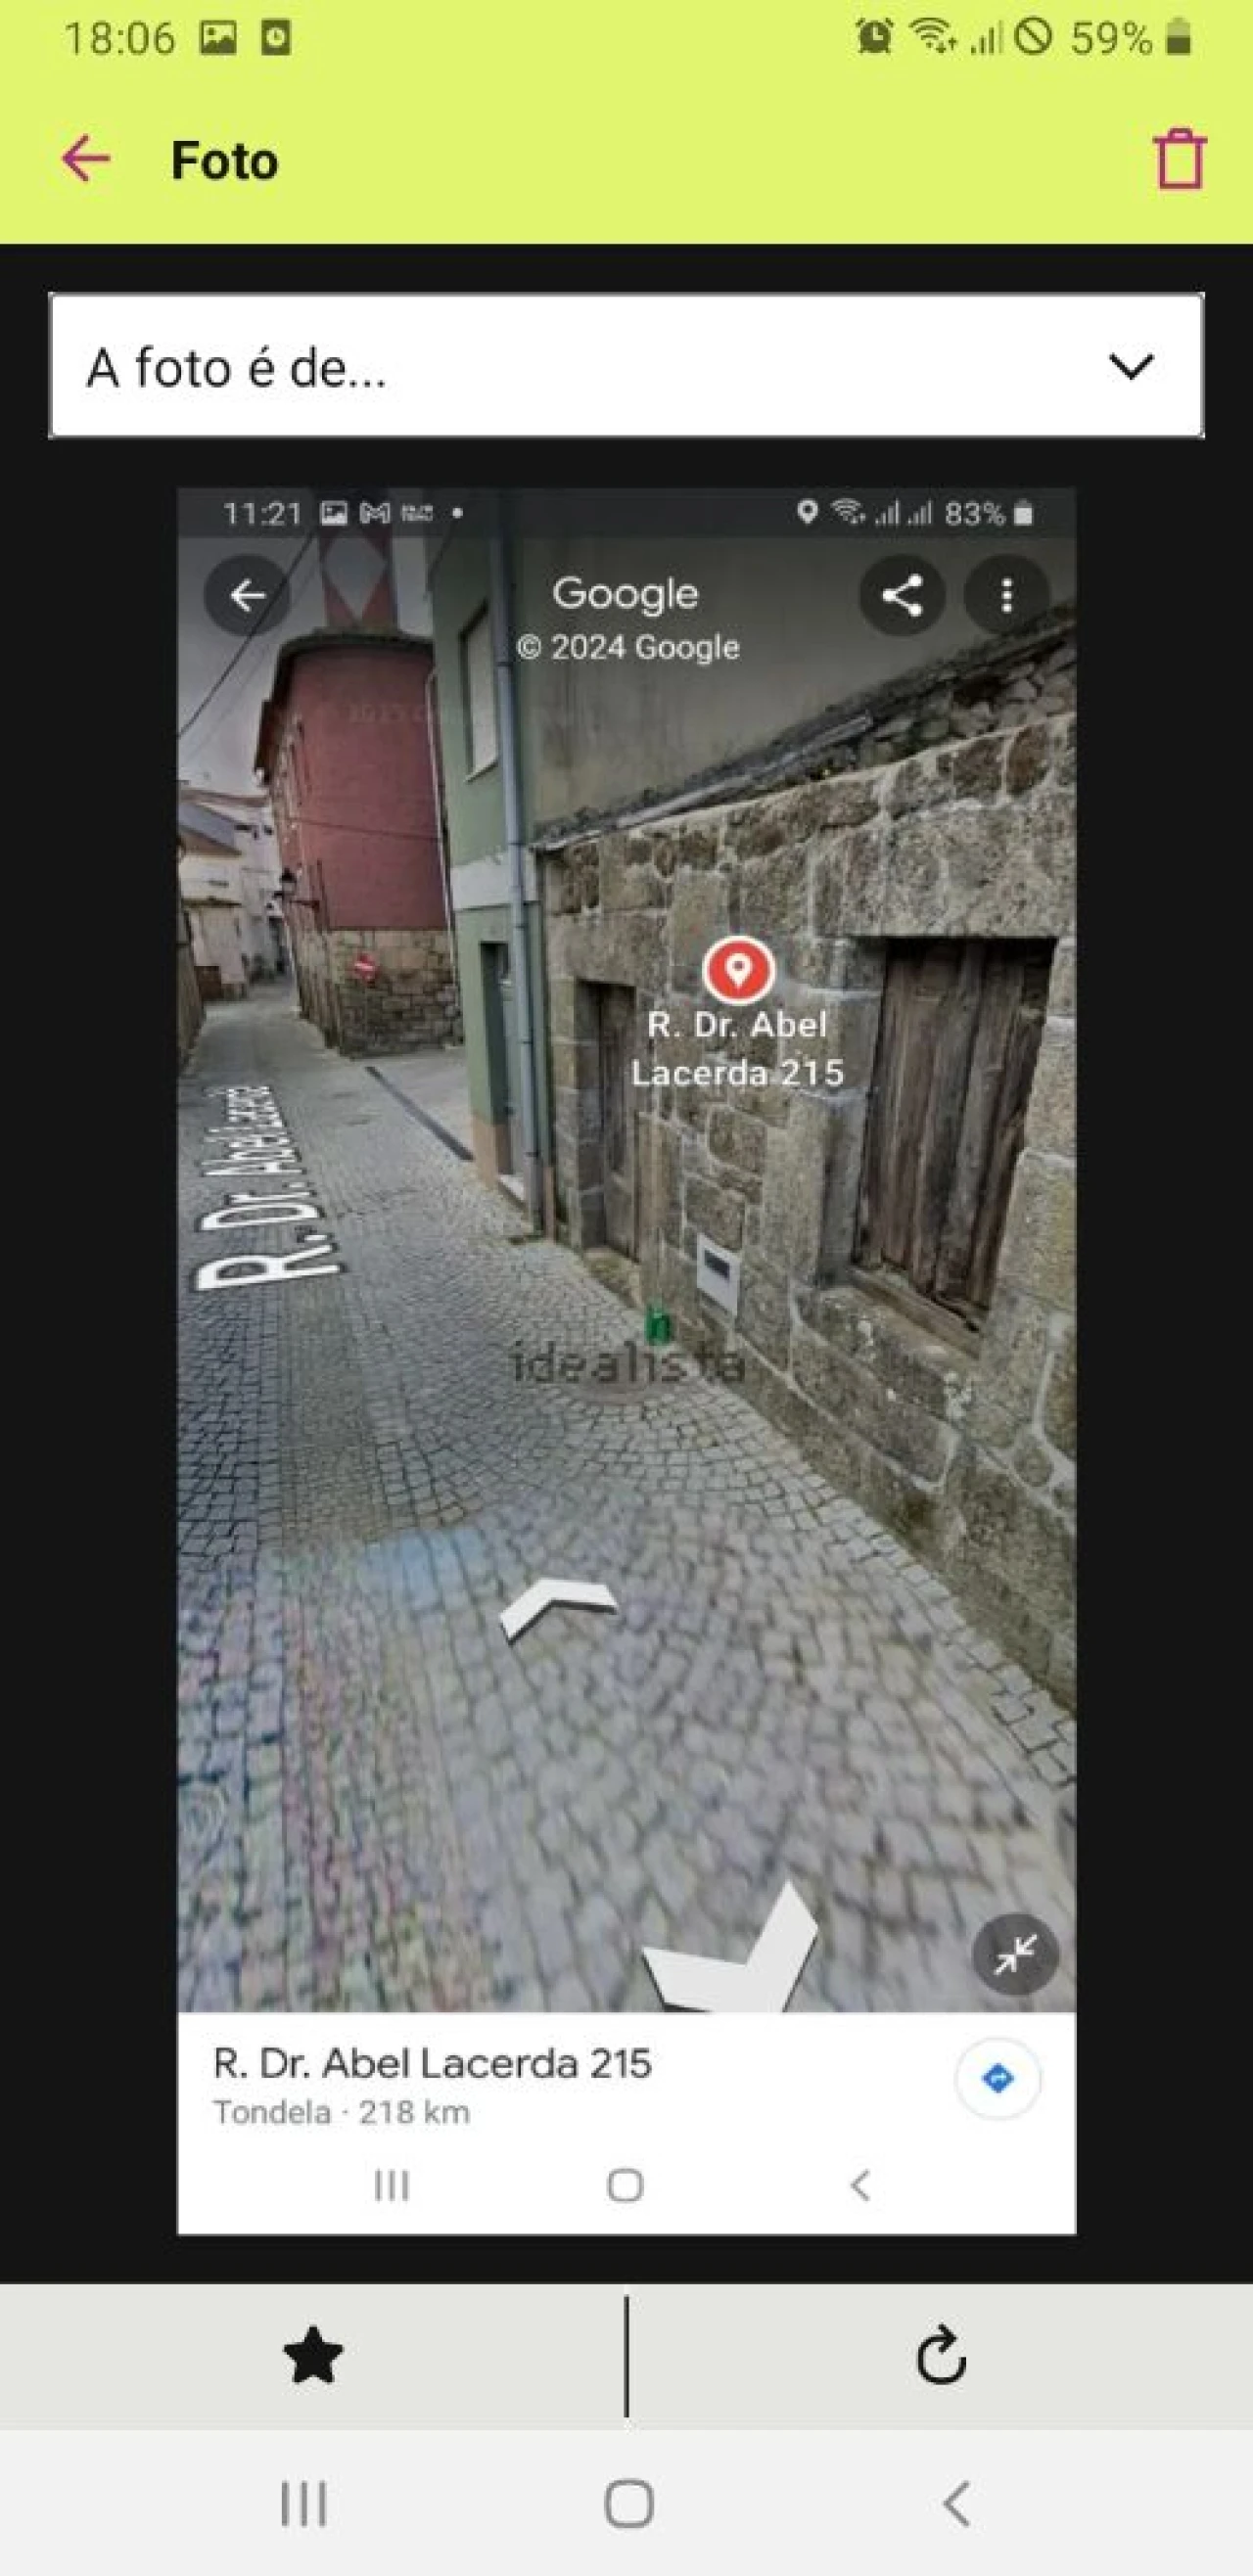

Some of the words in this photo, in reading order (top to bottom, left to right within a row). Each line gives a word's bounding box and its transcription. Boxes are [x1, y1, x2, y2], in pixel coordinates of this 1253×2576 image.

[65, 21, 175, 56] 18:06
[1071, 21, 1153, 56] 59%
[172, 140, 279, 181] Foto
[87, 347, 119, 389] A
[135, 345, 231, 389] foto
[249, 346, 275, 389] é
[291, 346, 387, 389] de...
[223, 502, 301, 525] 11:21
[946, 502, 1005, 525] 83%
[213, 2047, 249, 2080] R.
[260, 2047, 311, 2080] Dr.
[323, 2047, 409, 2080] Abel
[421, 2047, 579, 2080] Lacerda
[589, 2047, 653, 2080] 215
[212, 2098, 331, 2125] Tondela
[358, 2098, 414, 2125] 218
[423, 2098, 471, 2125] km
